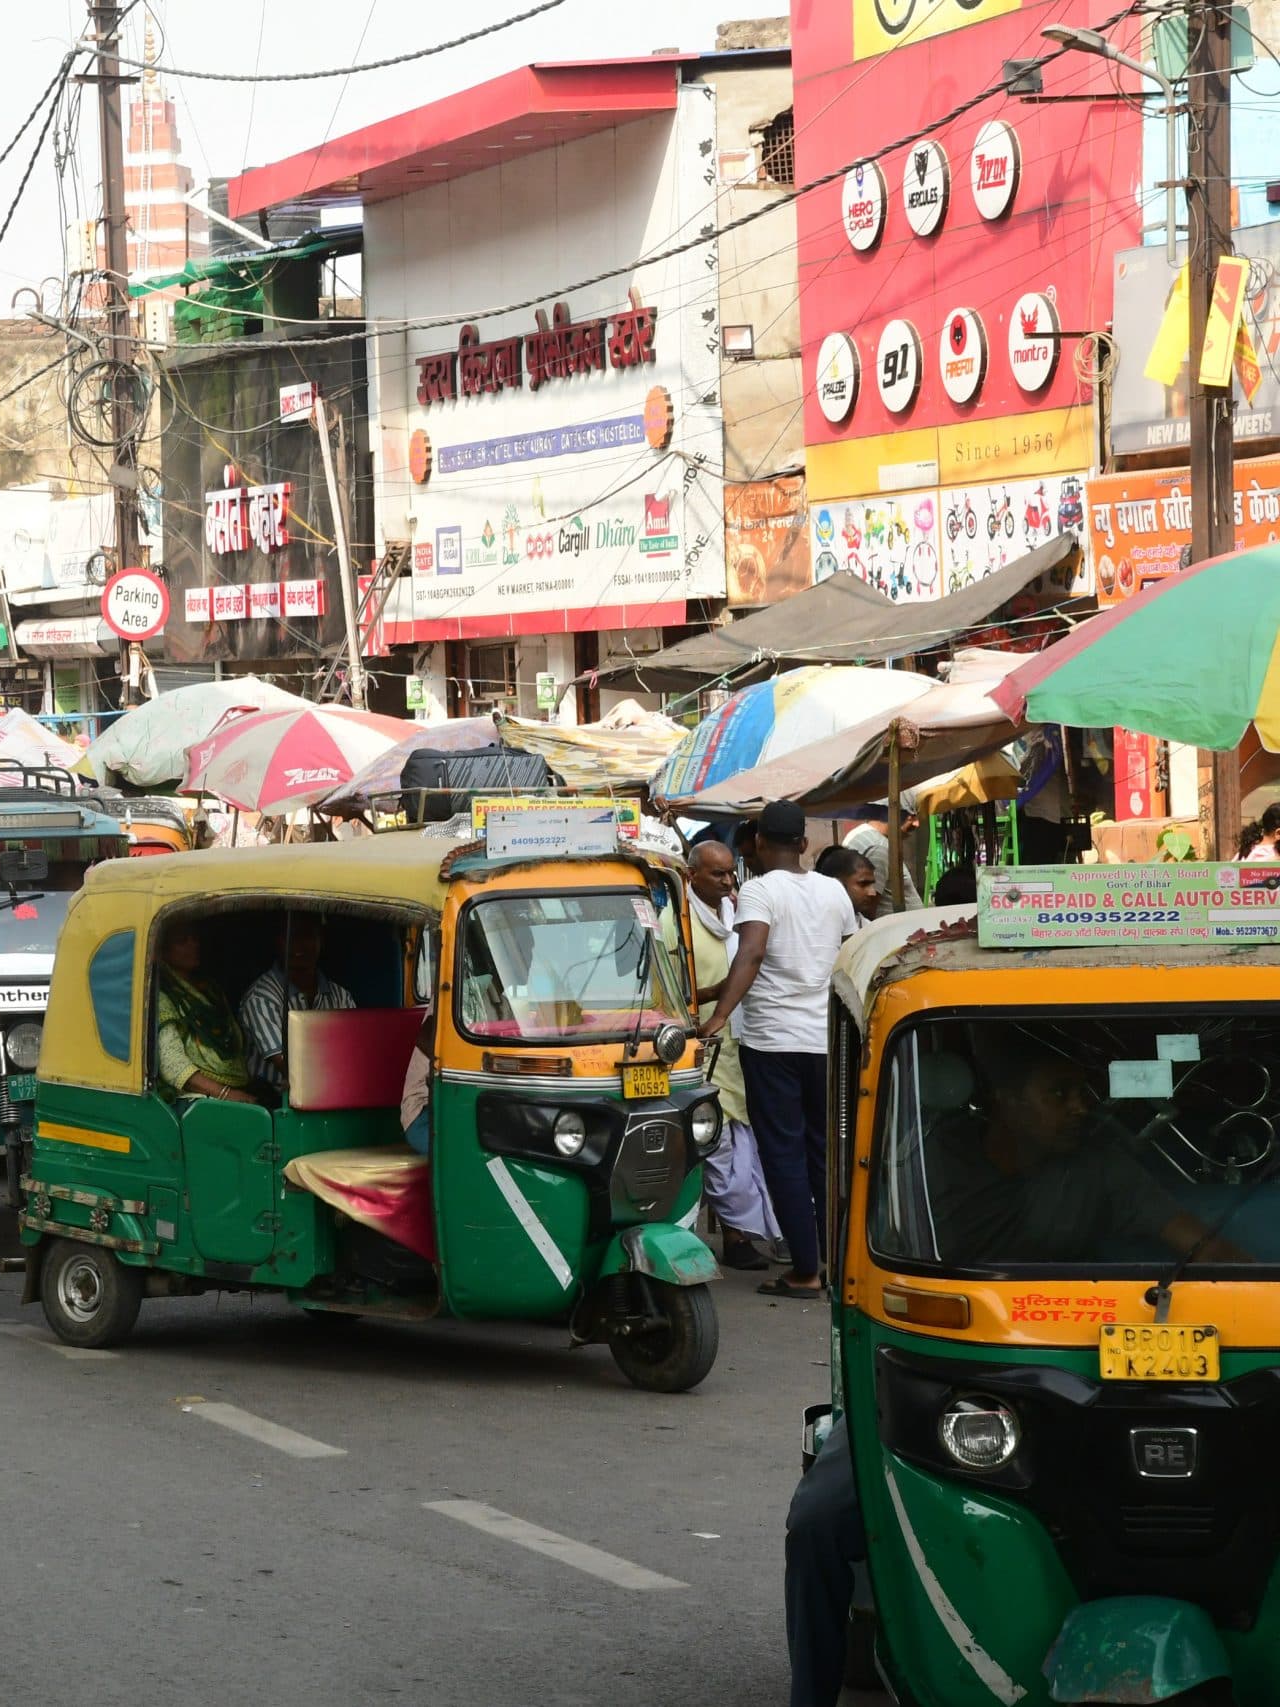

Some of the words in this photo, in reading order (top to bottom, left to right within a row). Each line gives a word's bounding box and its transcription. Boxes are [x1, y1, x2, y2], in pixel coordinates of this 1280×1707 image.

[976, 154, 1007, 190] AVON
[908, 186, 938, 209] HERCULES
[849, 200, 873, 218] HERO
[1013, 344, 1049, 365] montra
[883, 343, 909, 389] 91
[1148, 424, 1173, 445] NEW
[1233, 413, 1272, 437] WEETS
[955, 440, 1001, 462] Since
[1012, 432, 1054, 456] 1956
[558, 524, 590, 557] Cargill
[115, 585, 159, 609] Parking
[121, 611, 148, 628] Area
[1070, 869, 1122, 883] Approved
[1124, 868, 1137, 881] by
[1177, 868, 1209, 880] Board
[1133, 880, 1145, 889] of
[1146, 879, 1172, 889] Bihar
[1019, 893, 1097, 910] PREPAID
[1103, 893, 1115, 909] &
[1121, 892, 1168, 908] CALL
[1175, 891, 1222, 907] AUTO
[1036, 910, 1181, 924] 8409352222
[1011, 1294, 1071, 1310] पुलिस
[1075, 1295, 1119, 1308] कोड
[1011, 1309, 1118, 1323] KOT-776
[1123, 1328, 1206, 1352] BR01P
[1143, 1444, 1186, 1468] RE
